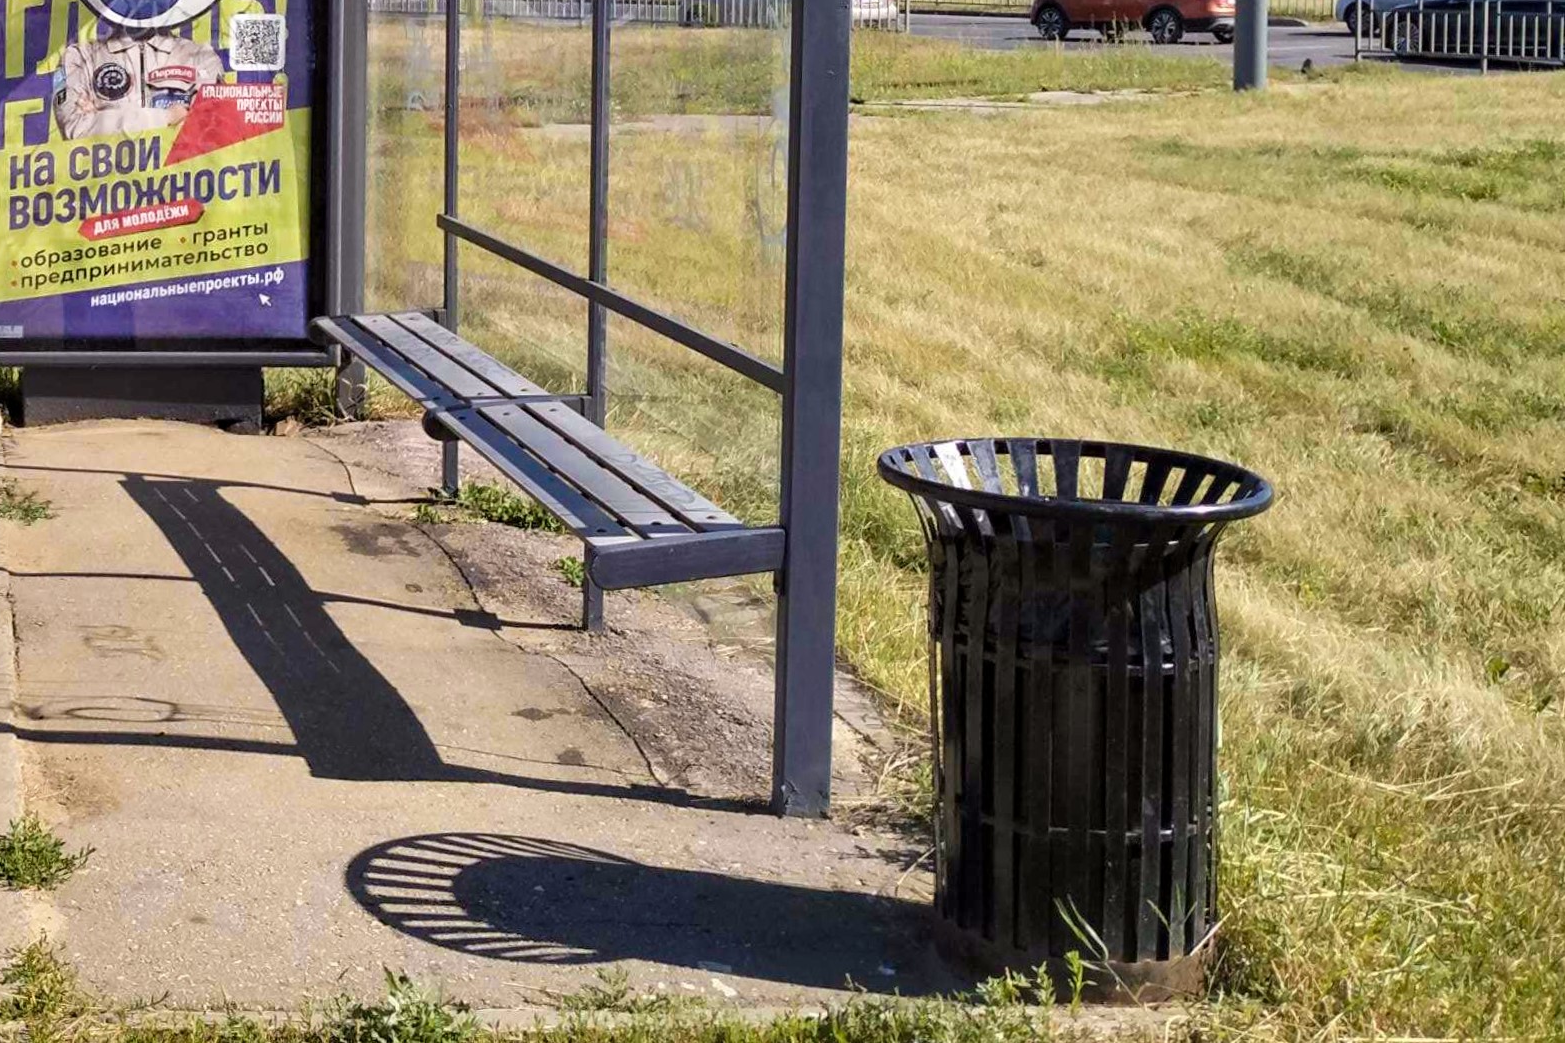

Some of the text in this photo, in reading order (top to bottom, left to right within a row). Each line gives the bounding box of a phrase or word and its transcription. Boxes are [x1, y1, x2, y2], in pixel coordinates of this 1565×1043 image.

[202, 85, 284, 99] НАЦИОНАЛЬНЫЕ
[237, 99, 283, 111] ПРОЕКТЫ
[244, 111, 283, 124] РОССИИ
[69, 136, 160, 182] СВОИ
[9, 159, 281, 231] ВОЗМОЖНОСТИ
[21, 223, 268, 271] образование гранты
[21, 242, 269, 290] предпринимательство
[91, 266, 285, 307] национальныепроекты.рф
